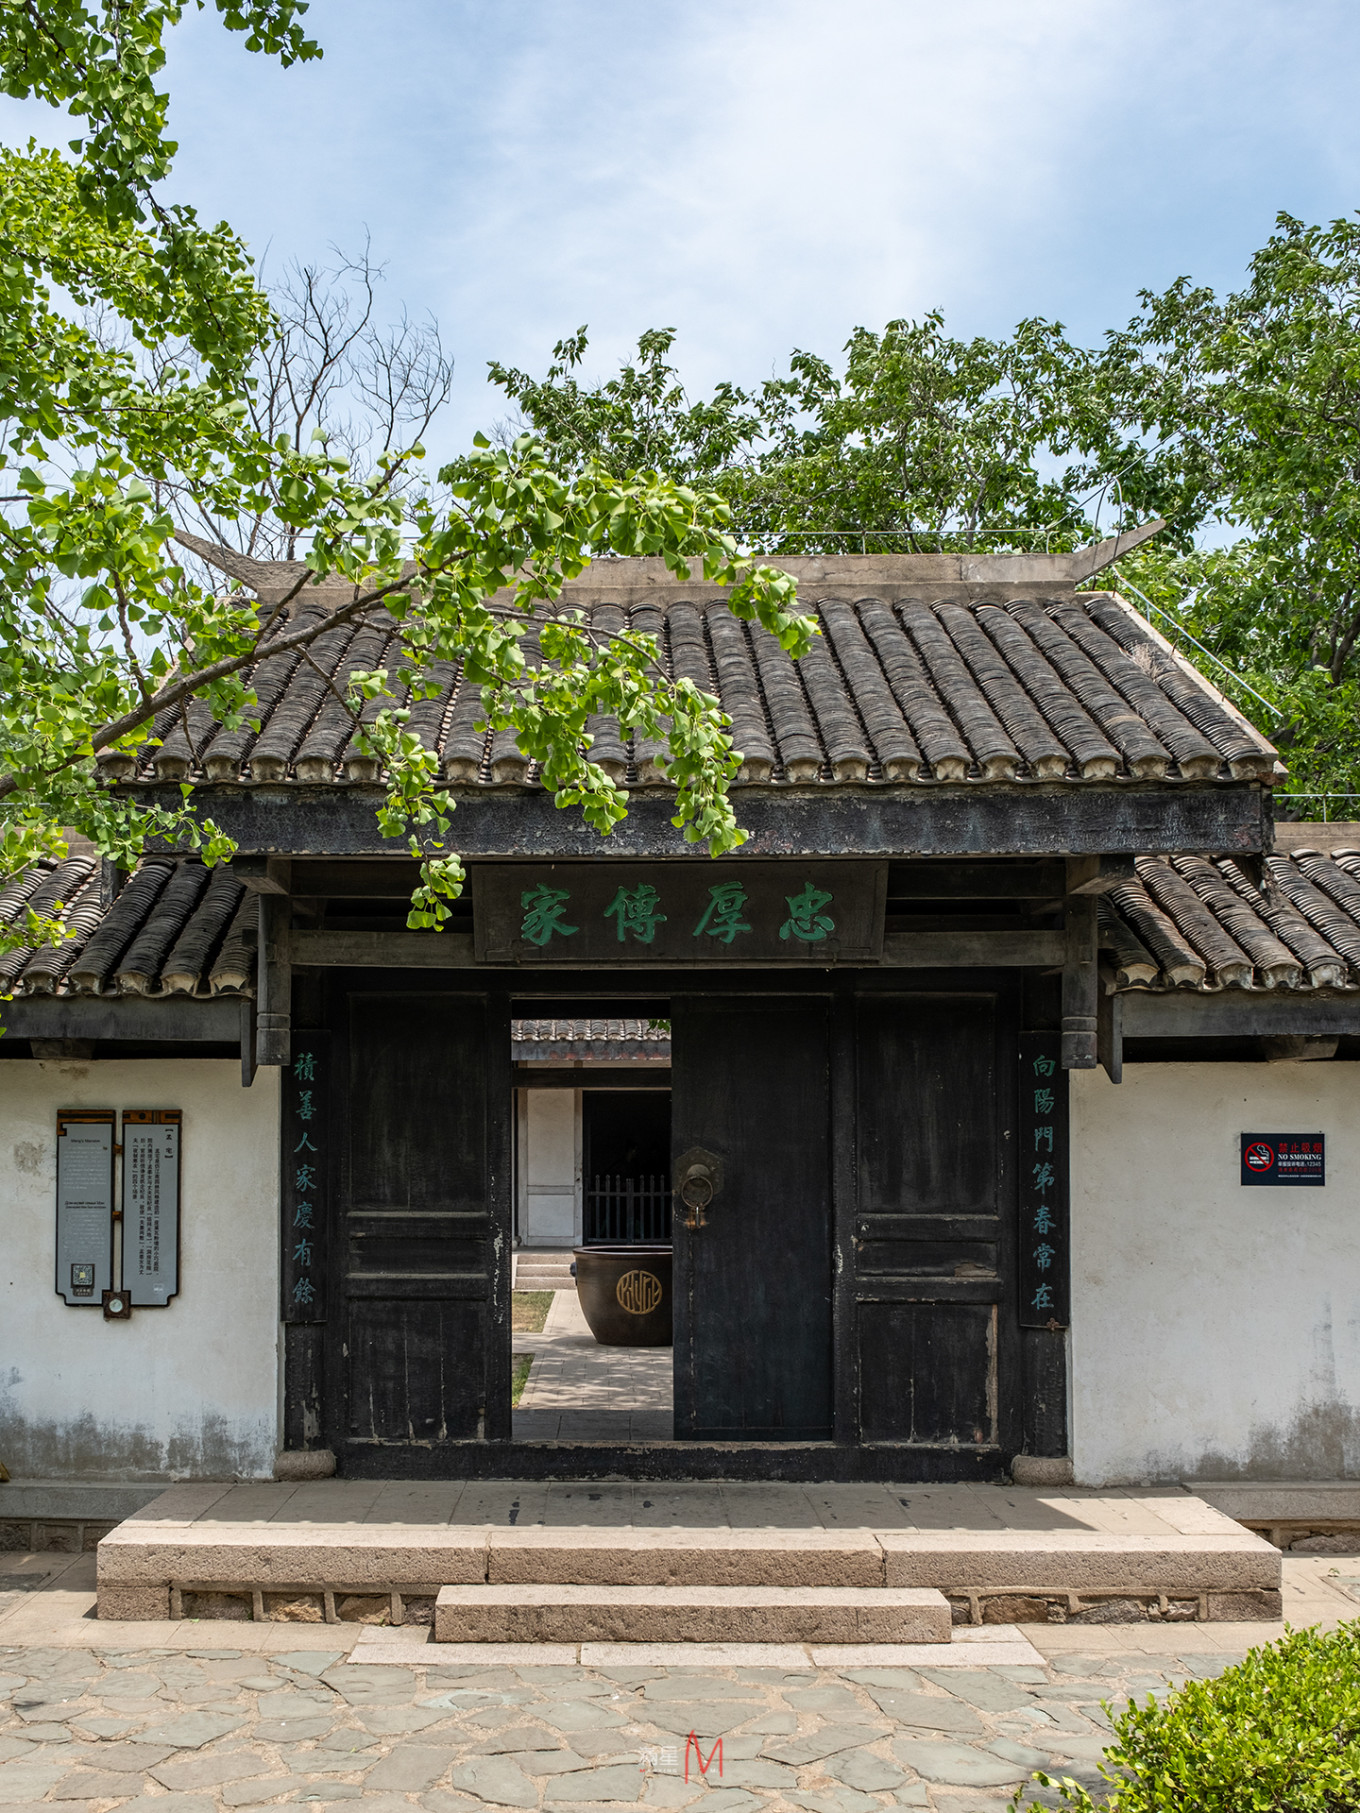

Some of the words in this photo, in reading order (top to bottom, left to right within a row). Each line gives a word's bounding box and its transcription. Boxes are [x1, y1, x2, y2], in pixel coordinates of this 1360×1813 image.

[520, 880, 835, 945] 忠厚傳家
[293, 1053, 318, 1304] 積善人家慶有餘
[1030, 1054, 1057, 1311] 向陽門第春常在
[1278, 1142, 1322, 1153] 禁止吸烟
